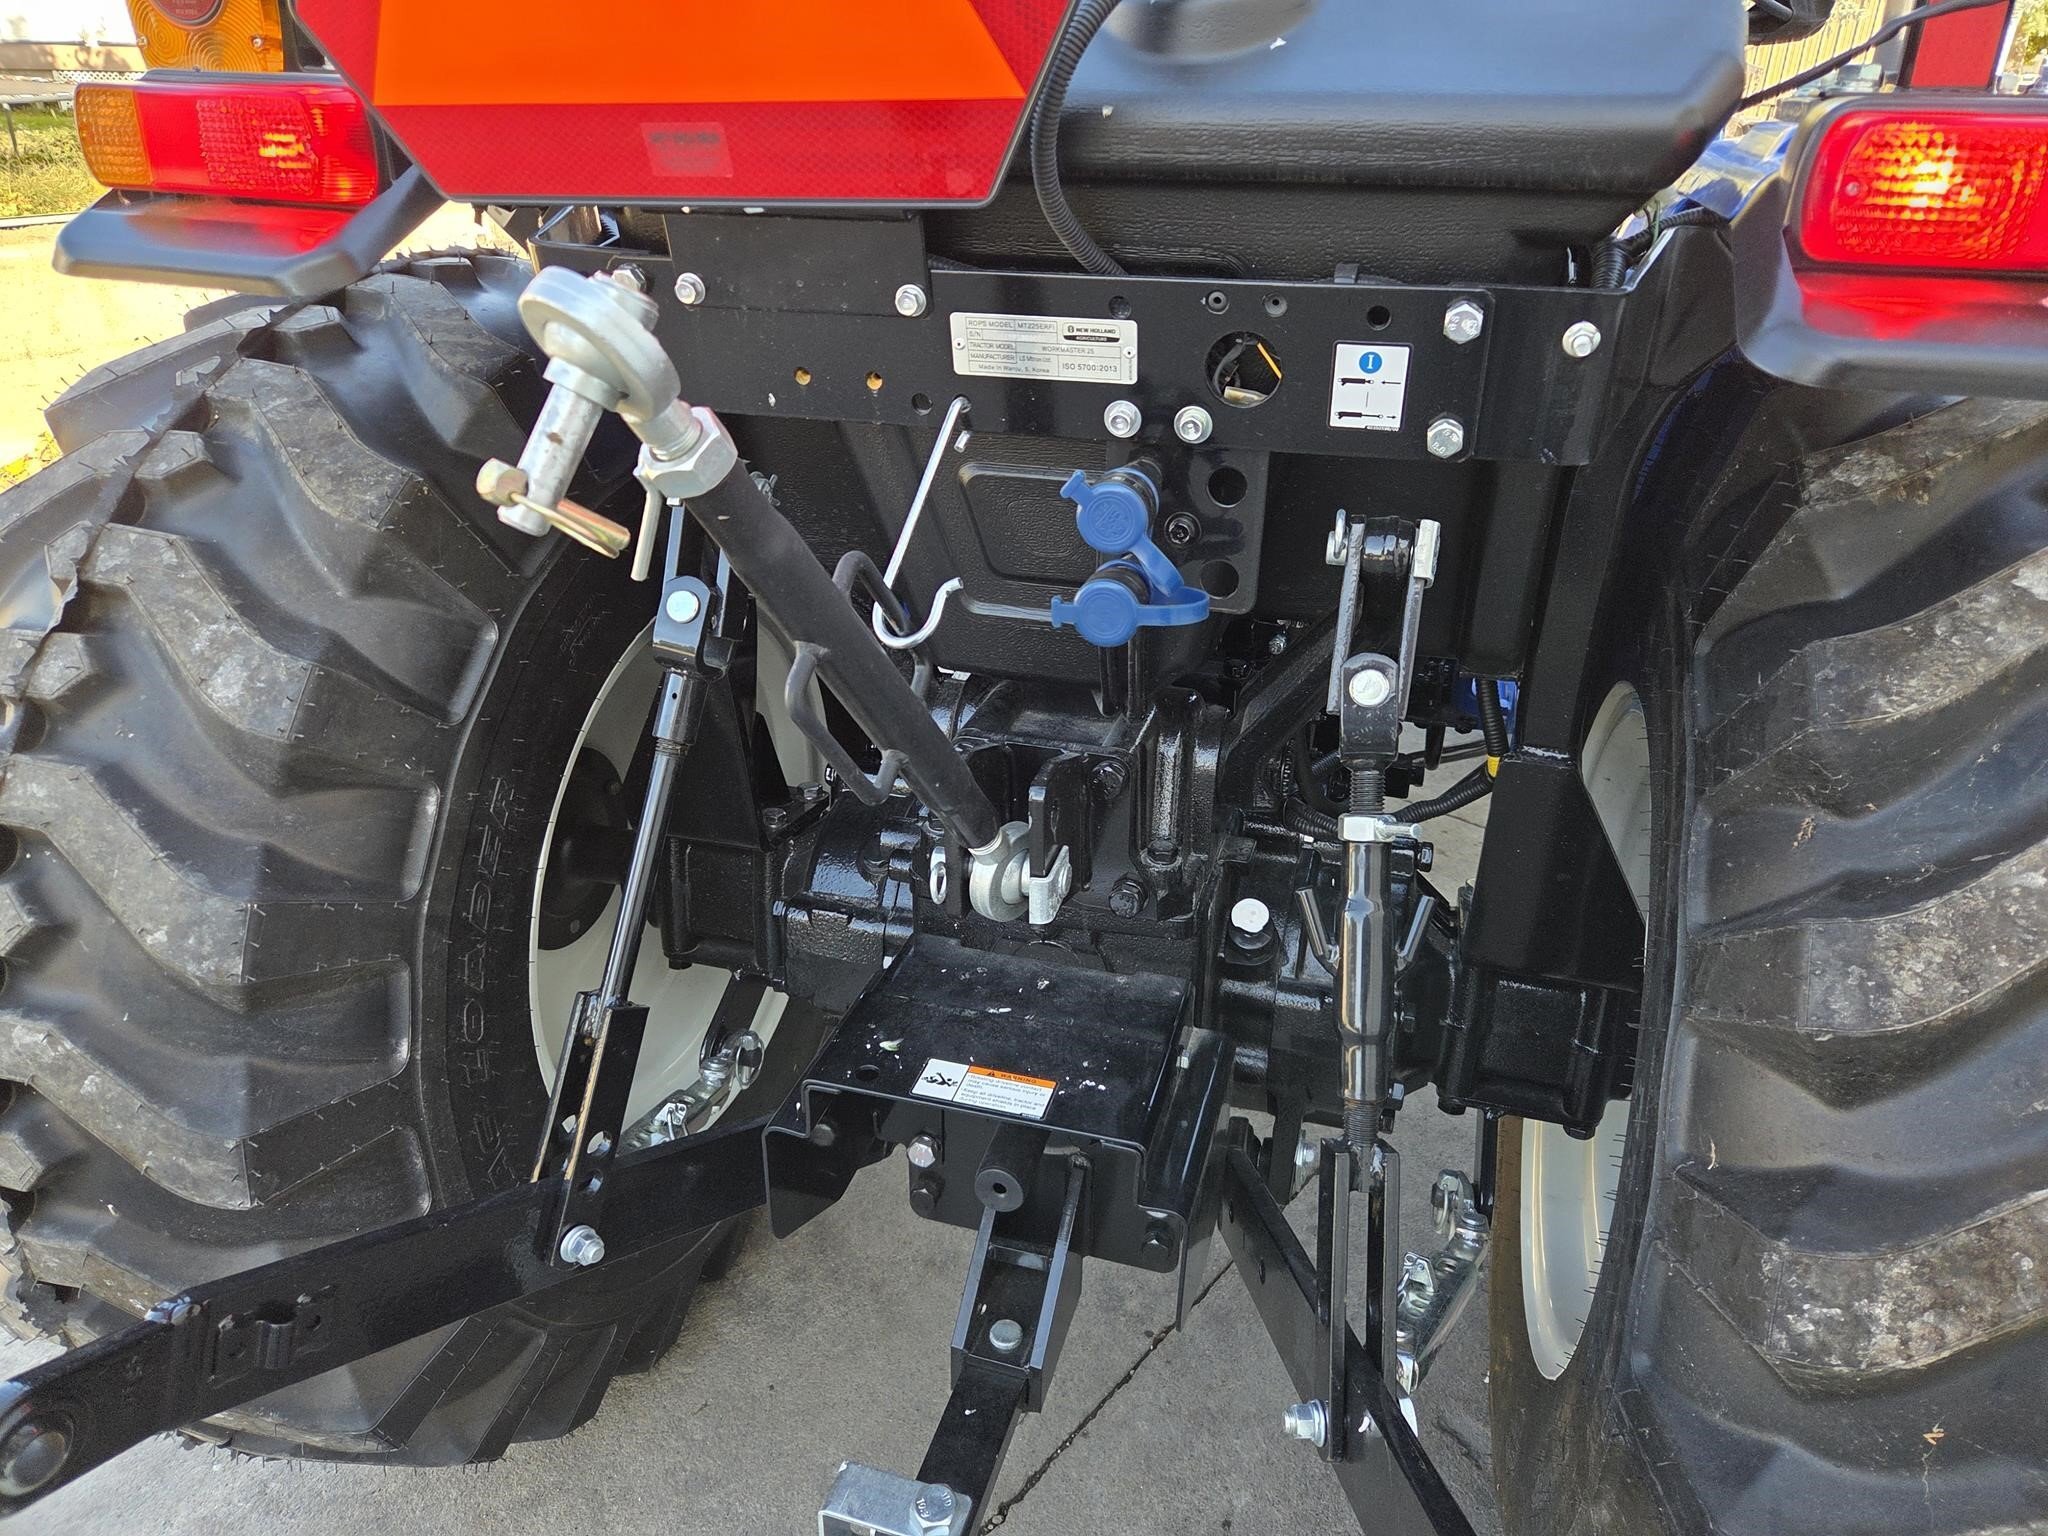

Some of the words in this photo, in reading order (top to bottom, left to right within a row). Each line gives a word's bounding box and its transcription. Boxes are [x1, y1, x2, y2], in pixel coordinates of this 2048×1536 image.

[1042, 346, 1085, 354] WORKMASTER
[970, 353, 1015, 361] MANUFACTURER
[1077, 364, 1117, 372] 5700:2013
[1000, 1074, 1037, 1084] WARNING
